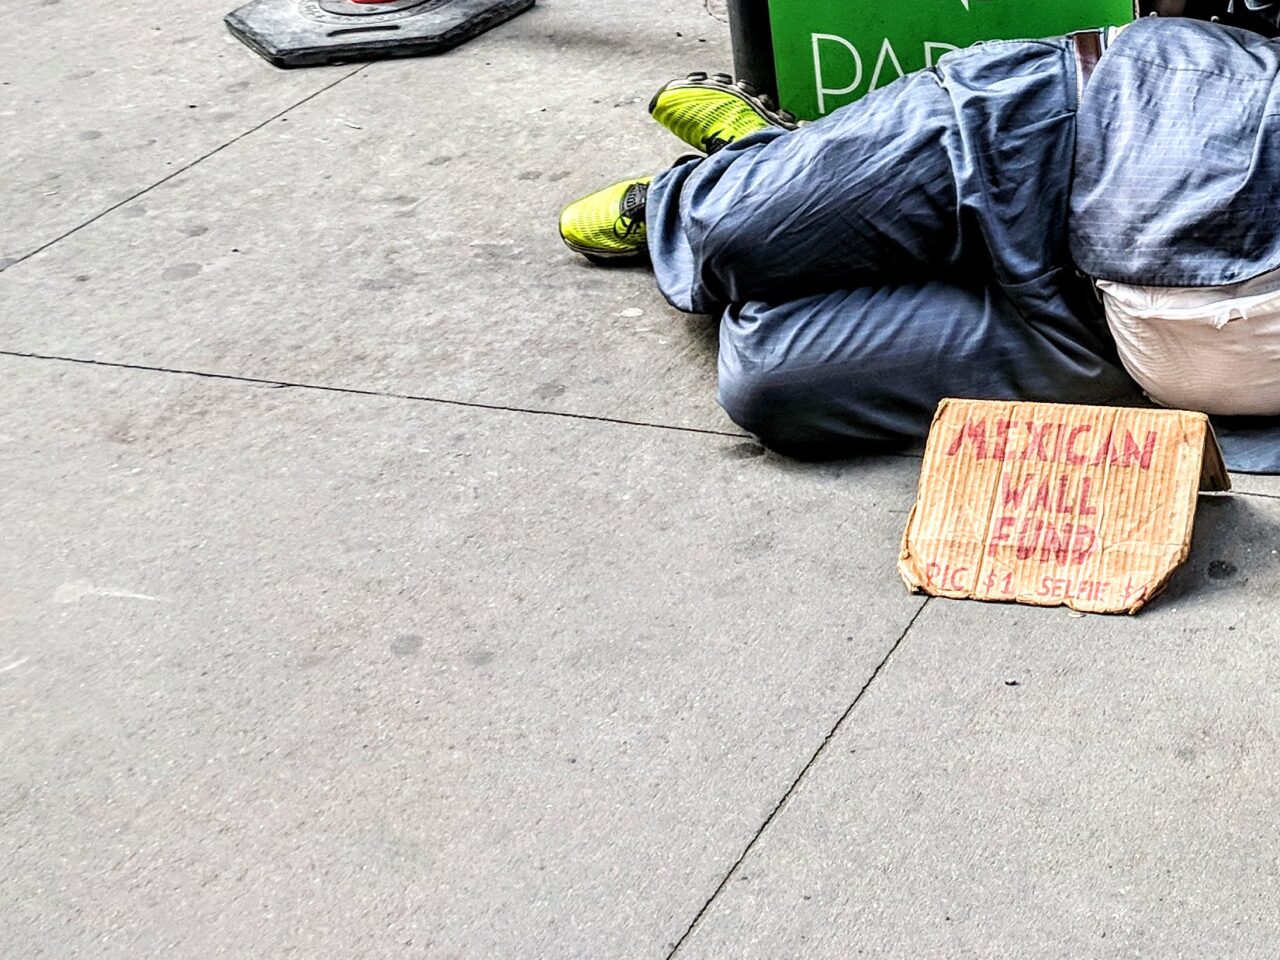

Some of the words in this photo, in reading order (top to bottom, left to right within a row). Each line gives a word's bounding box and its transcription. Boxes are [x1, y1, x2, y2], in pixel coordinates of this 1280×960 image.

[947, 416, 1158, 471] MEXICAN
[999, 470, 1097, 515] WALL
[987, 515, 1099, 567] FUND
[926, 562, 968, 591] PIC
